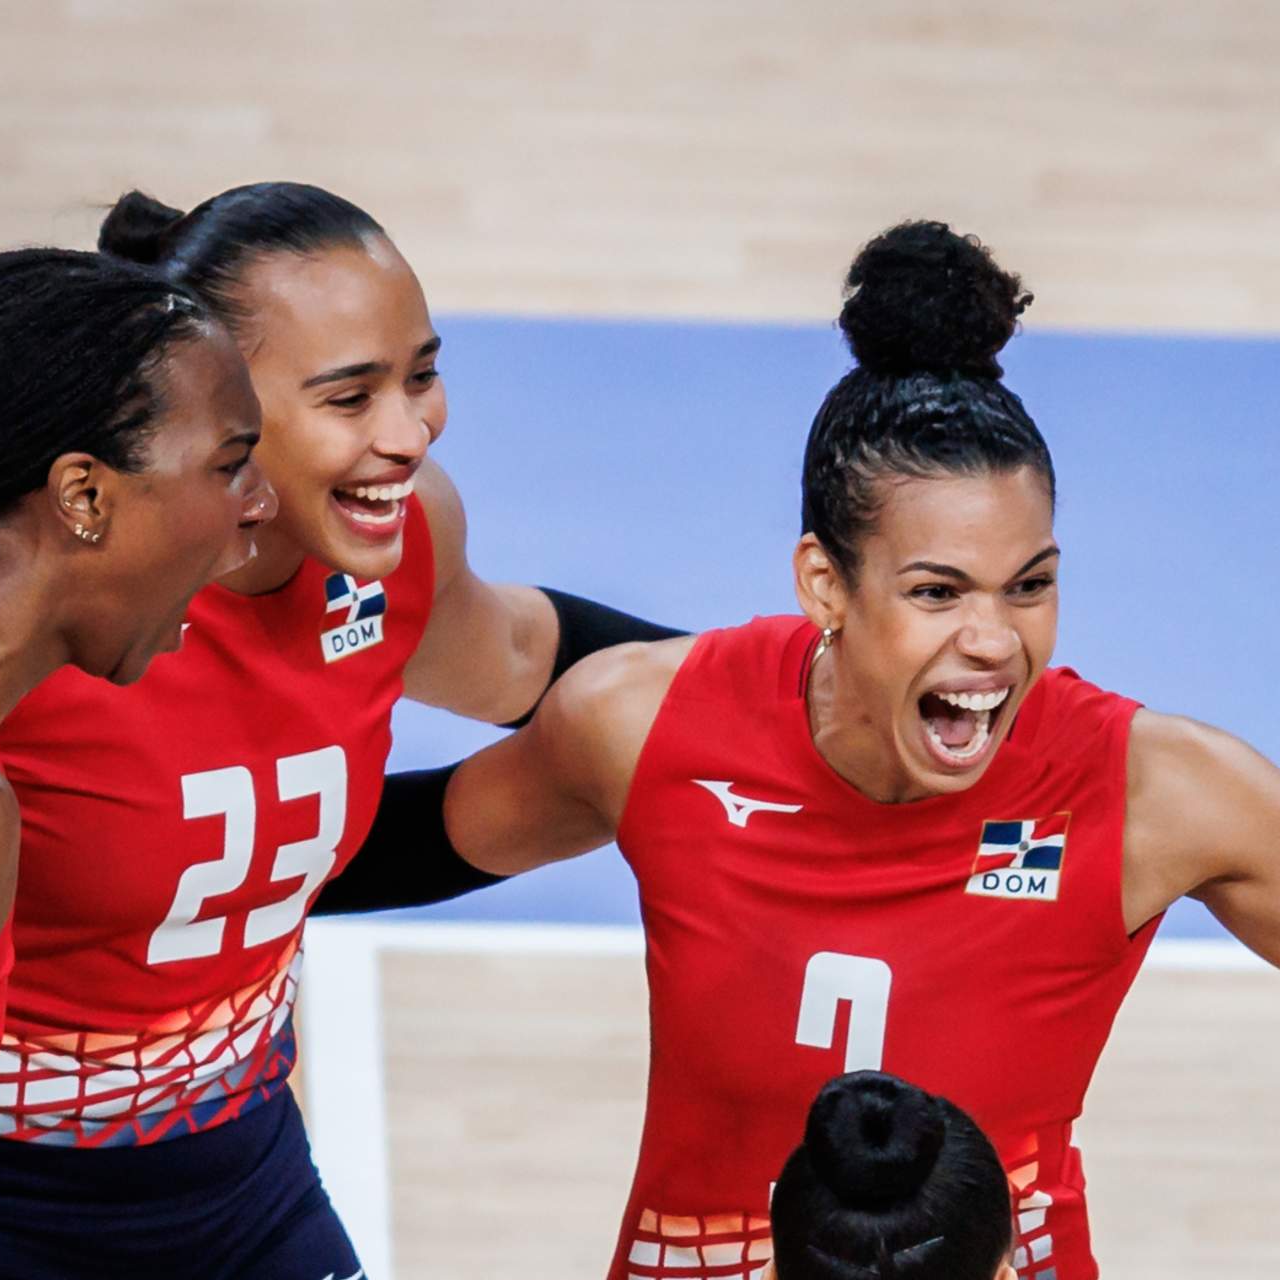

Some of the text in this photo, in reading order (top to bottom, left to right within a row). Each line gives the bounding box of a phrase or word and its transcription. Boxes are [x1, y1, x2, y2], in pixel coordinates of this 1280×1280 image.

[331, 621, 376, 653] DOM
[147, 745, 348, 965] 23
[982, 872, 1047, 894] DOM
